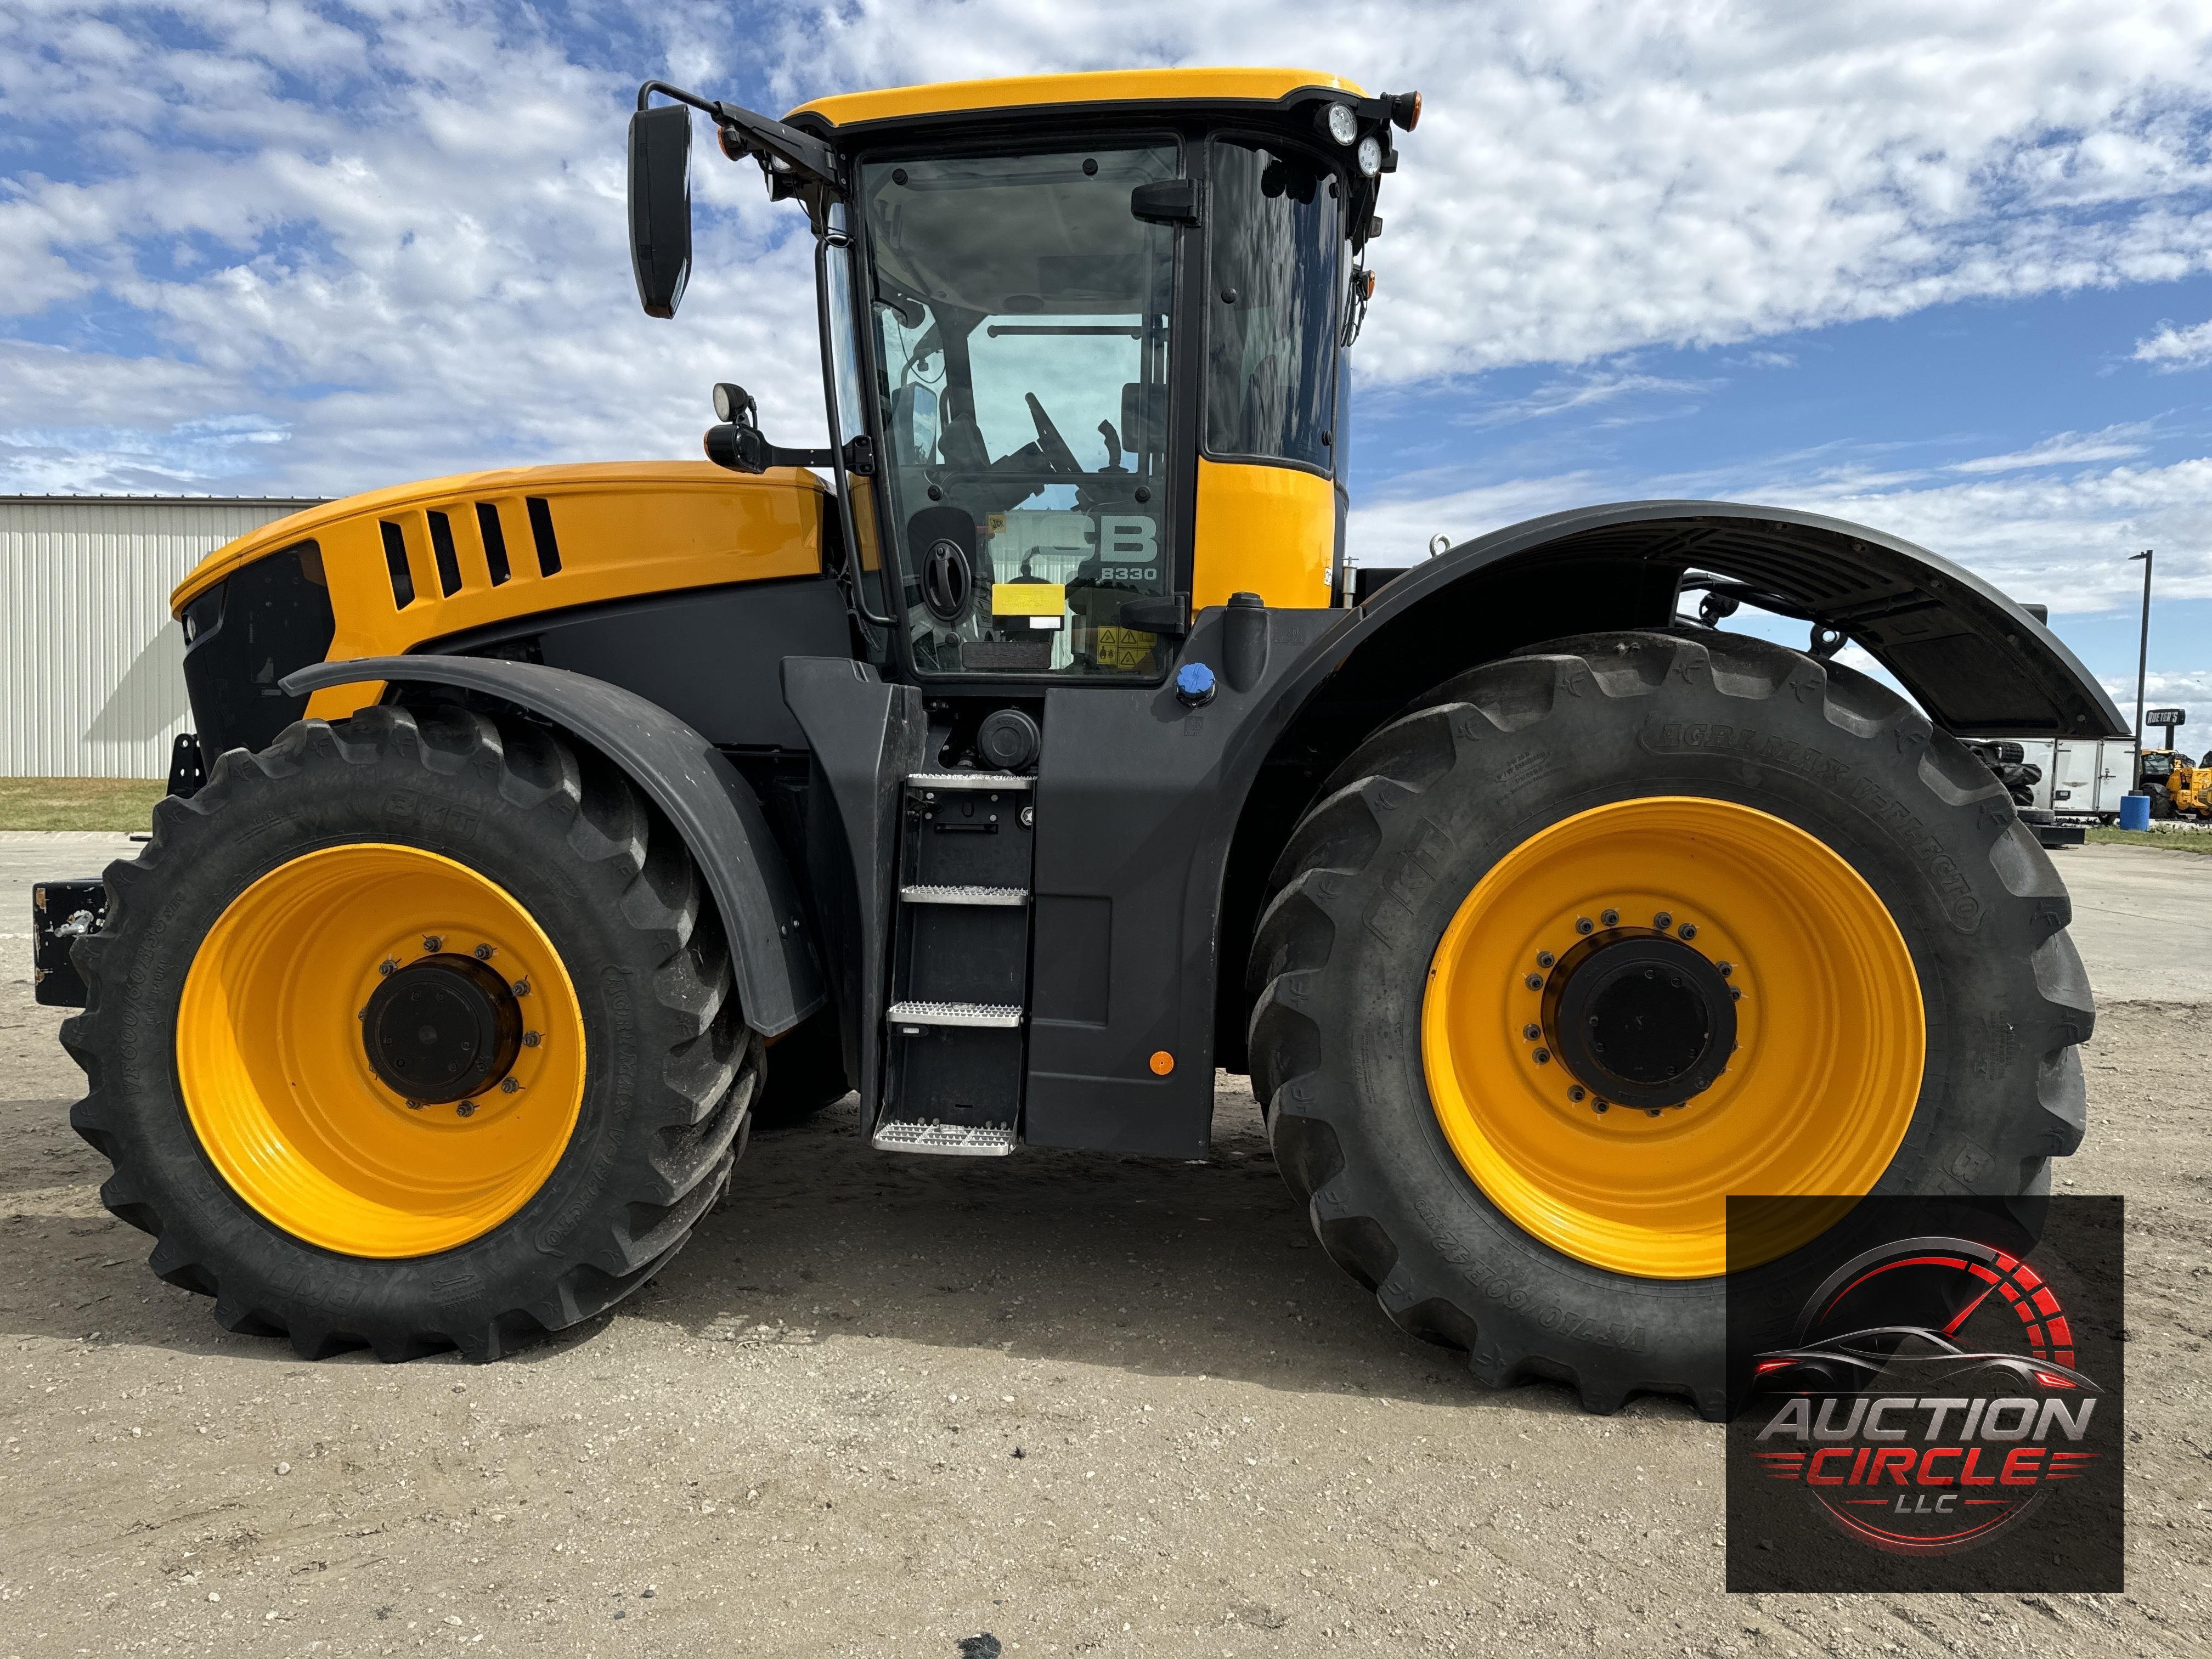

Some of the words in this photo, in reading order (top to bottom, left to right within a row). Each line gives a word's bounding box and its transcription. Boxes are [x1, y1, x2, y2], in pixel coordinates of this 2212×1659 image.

[1655, 721, 1758, 751] AGRI
[1759, 733, 1851, 783] MAX
[1850, 775, 1980, 920] V-FLECTO
